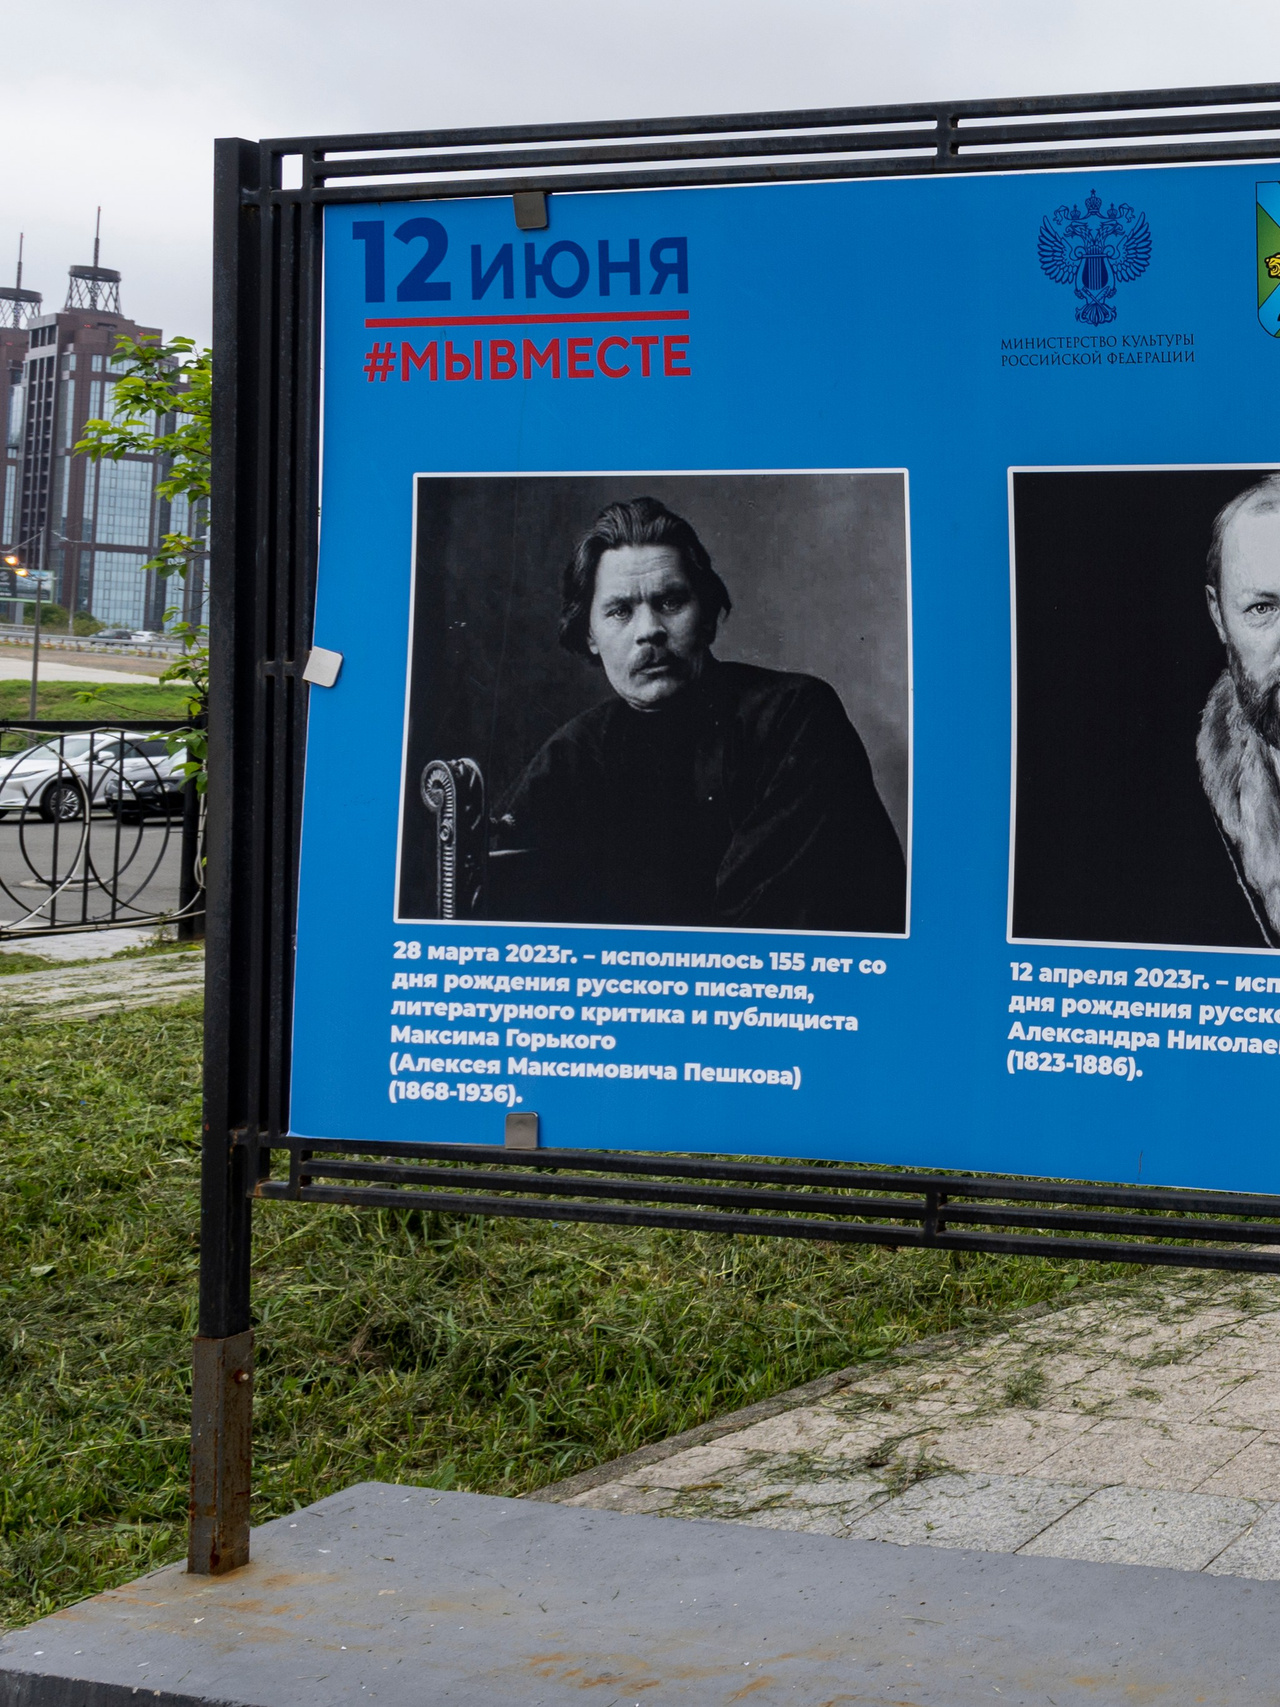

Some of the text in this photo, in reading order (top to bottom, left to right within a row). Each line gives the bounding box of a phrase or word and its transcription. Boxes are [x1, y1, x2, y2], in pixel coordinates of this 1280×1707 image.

[351, 216, 690, 304] 12 ИЮНЯ
[1000, 333, 1195, 350] МИНИСТЕРСТВО КУЛЬТУРЫ
[362, 334, 692, 383] #МЫВМЕСТЕ
[1001, 350, 1196, 367] РОССИЙСКОЙ ФЕДЕРАЦИИ
[393, 940, 422, 960] 28
[427, 945, 500, 966] марта
[505, 943, 578, 964] 2023г.
[601, 950, 764, 970] исполнилось
[769, 951, 806, 971] 155
[810, 957, 854, 973] лет
[858, 959, 887, 975] со
[391, 972, 815, 1004] дня рождения русского писателя,
[1010, 962, 1033, 982] 12
[1038, 967, 1128, 989] апреля
[1134, 967, 1210, 990] 2023г.
[390, 1000, 859, 1031] литературного критика и публициста
[1008, 995, 1055, 1014] дня
[1061, 997, 1192, 1020] рождения
[390, 1024, 617, 1052] Максима Горького
[1007, 1021, 1160, 1052] Александра
[389, 1052, 802, 1090] (Алексея Максимовича Пешкова)
[1006, 1049, 1143, 1082] (1823-1886).
[388, 1079, 523, 1108] (1868-1936).
